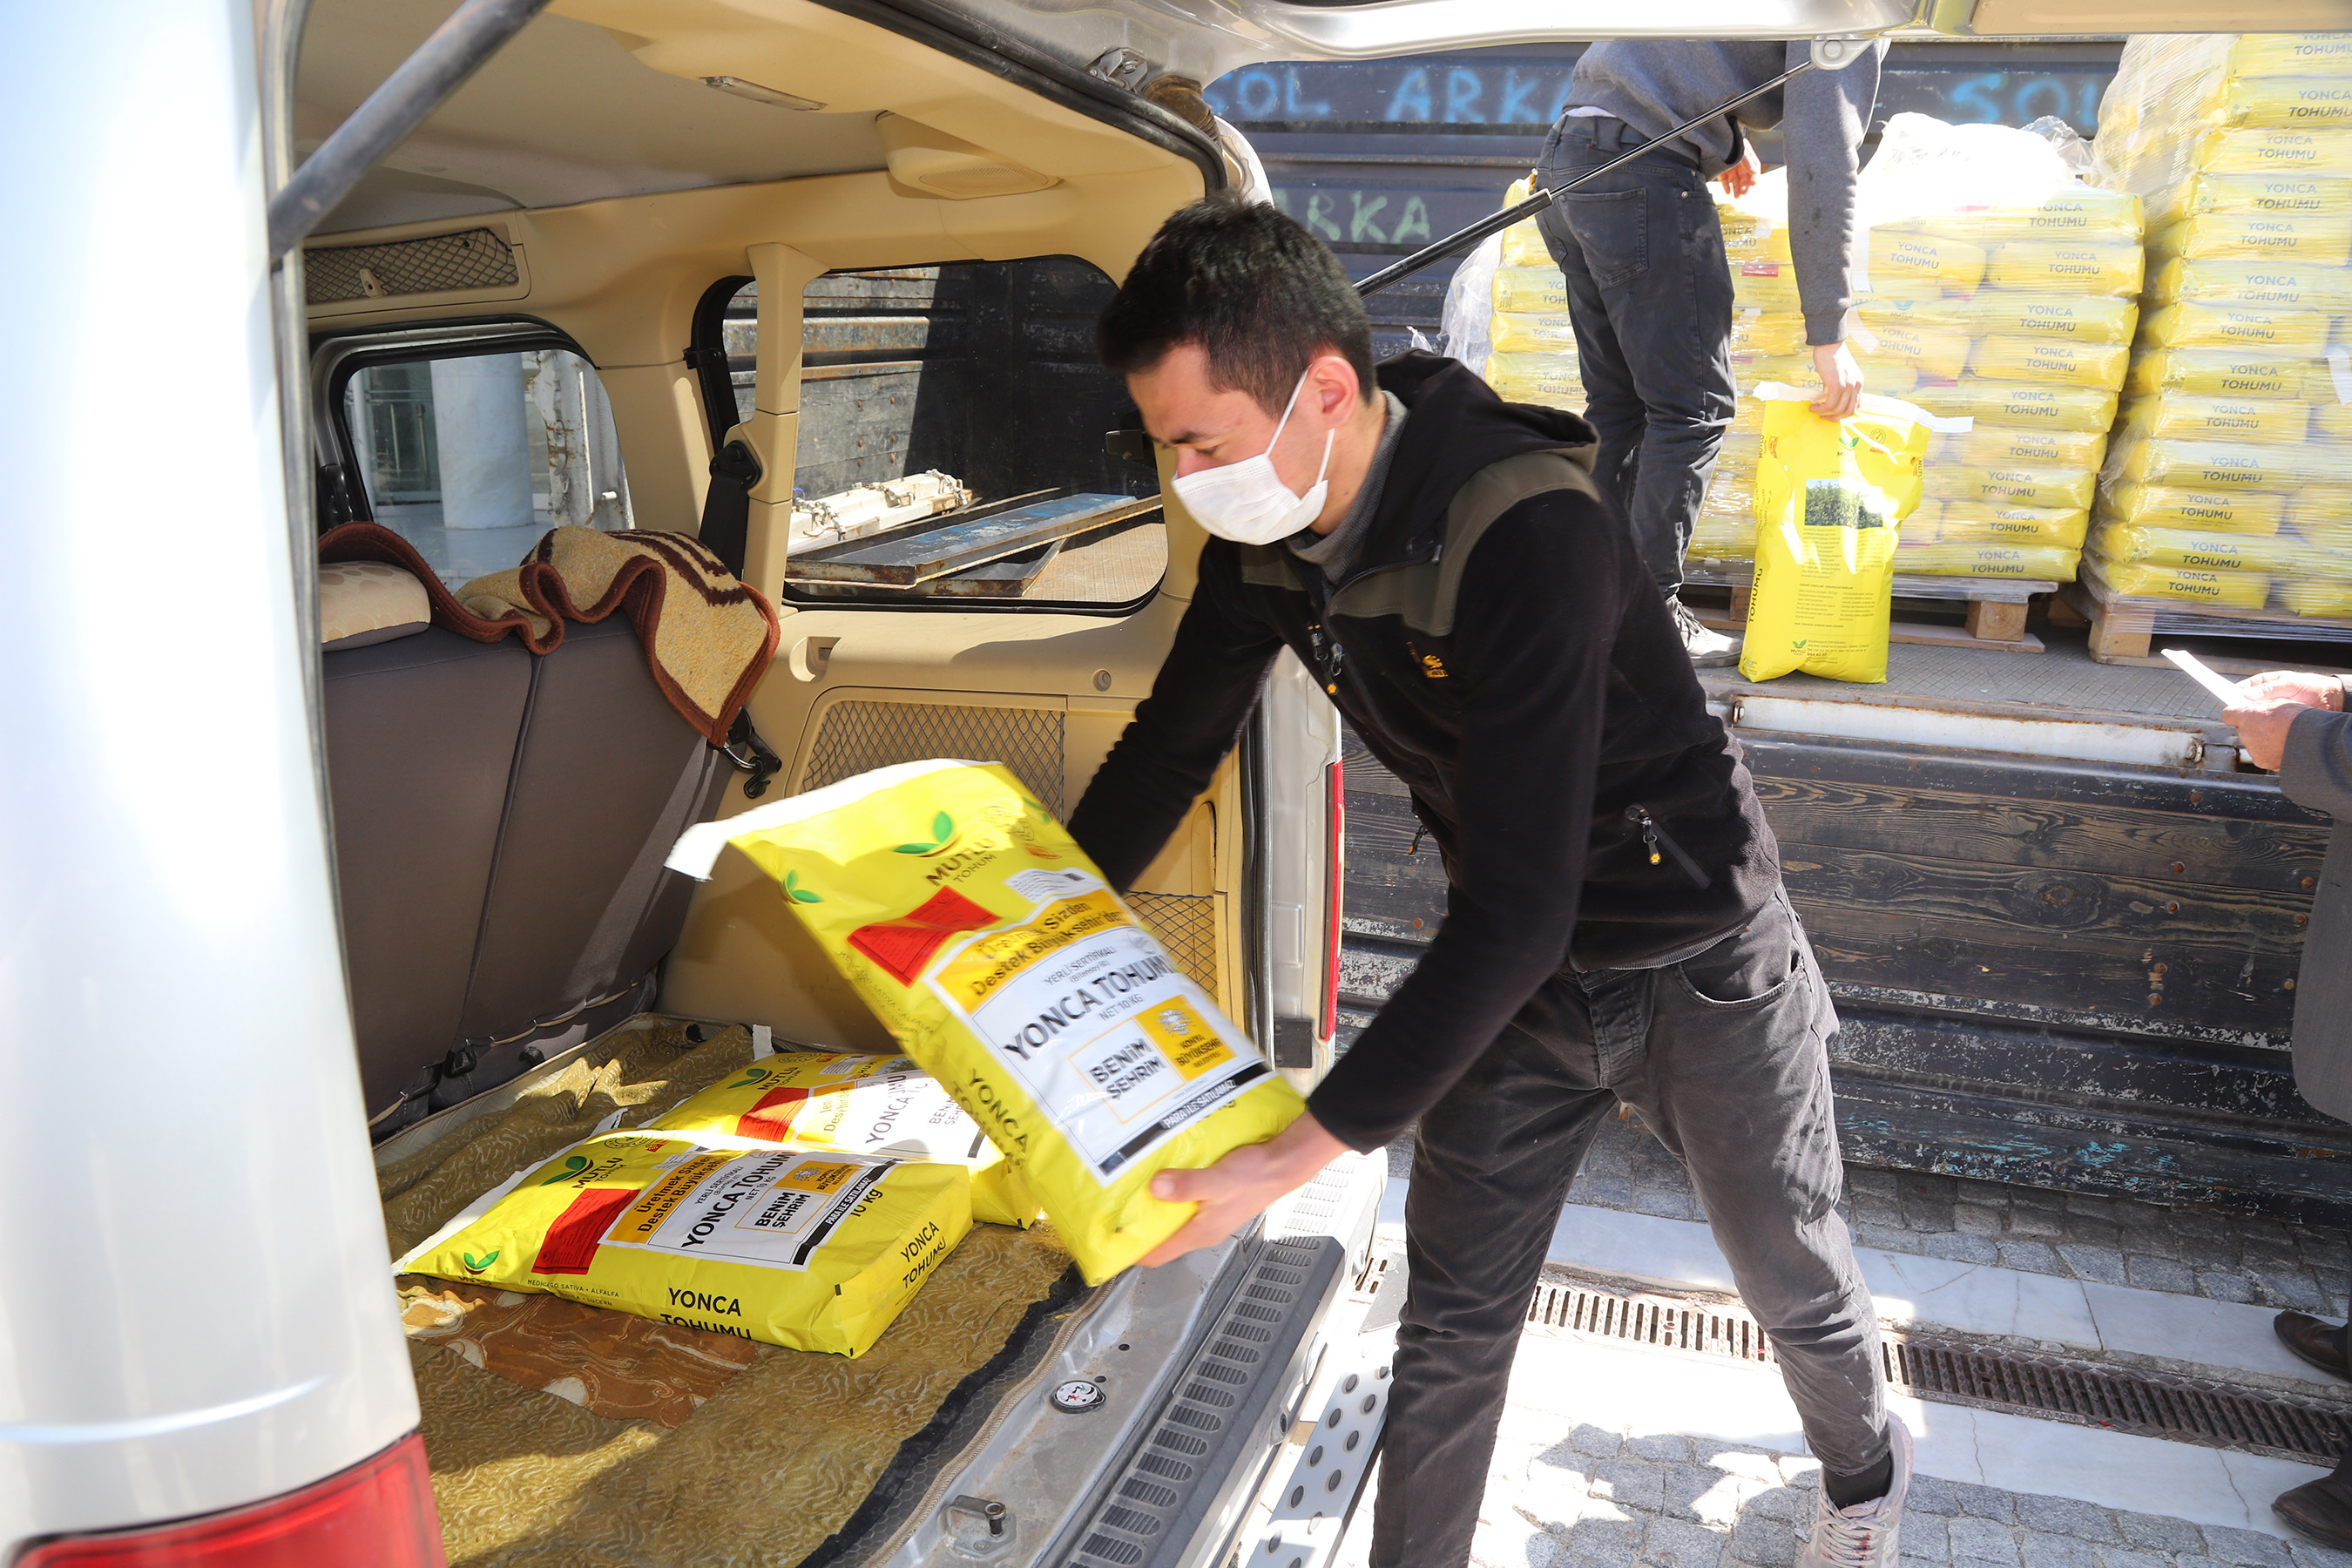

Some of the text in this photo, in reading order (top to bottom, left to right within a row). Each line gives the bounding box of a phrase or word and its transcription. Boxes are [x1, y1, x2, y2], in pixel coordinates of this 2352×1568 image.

[2298, 90, 2352, 100] YONCA
[2266, 135, 2313, 145] YONCA
[2257, 148, 2316, 159] TOHUMU
[2265, 184, 2317, 193] YONCA
[2255, 199, 2321, 210] TOHUMU
[2029, 217, 2087, 227] TOHUMU
[2247, 222, 2294, 233] YONCA
[2240, 235, 2297, 247] TOHUMU
[1897, 241, 1937, 257] YONCA
[1890, 253, 1940, 269] TOHUMU
[2055, 251, 2097, 261] YONCA
[2048, 263, 2100, 274] TOHUMU
[2245, 275, 2296, 287] YONCA
[1543, 294, 1566, 305] TOH
[2237, 290, 2300, 302] TOHUMU
[2027, 305, 2073, 317] YONCA
[2227, 313, 2272, 324] YONCA
[2019, 319, 2076, 332] TOHUMU
[1882, 327, 1920, 341] YONCA
[2220, 326, 2275, 339] TOHUMU
[1880, 340, 1922, 355] OHUMU
[2033, 347, 2074, 358] YONCA
[2026, 358, 2077, 372] TOHUMU
[2229, 365, 2279, 376] YONCA
[2220, 379, 2281, 391] TOHUMU
[2011, 391, 2055, 402] YONCA
[2004, 404, 2058, 417] TOHUMU
[2212, 405, 2256, 416] YONCA
[2206, 417, 2260, 429] TOHUMU
[2016, 435, 2056, 446] YONCA
[2010, 448, 2058, 459] TOHUMU
[2211, 456, 2260, 468] YONCA
[1988, 471, 2033, 483] YONCA
[2203, 470, 2263, 483] TOHUMU
[1981, 484, 2036, 497] TOHUMU
[2186, 494, 2230, 506] YONCA
[1996, 510, 2036, 521] YONCA
[2180, 507, 2233, 520] TOHUMU
[1990, 523, 2038, 534] TOHUMU
[2191, 541, 2239, 555] YONCA
[1977, 551, 2021, 560] YONCA
[2182, 555, 2241, 569] TOHUMU
[1971, 562, 2024, 574] TOHUMU
[2175, 570, 2217, 583] YONCA
[2168, 582, 2220, 596] TOHUMU
[1748, 568, 1763, 624] TOHUMU
[925, 837, 996, 887] MUTLU
[953, 853, 997, 884] TOHUM
[1044, 901, 1093, 930] Sizden
[969, 950, 1031, 997] Destek
[1004, 955, 1176, 1062] YONCA TOHUM
[1098, 1004, 1119, 1022] NET
[758, 1066, 799, 1091] MUTLU
[969, 1067, 1029, 1153] YONCA
[1161, 1109, 1188, 1129] PARA
[1196, 1078, 1238, 1106] SATILAMAZ
[865, 1096, 916, 1145] YONCA
[571, 1157, 624, 1189] MUTLU
[636, 1174, 683, 1213] Üretmek
[681, 1191, 747, 1247] YONCA
[731, 1152, 797, 1190] TOHUM
[745, 1188, 760, 1200] NET
[826, 1210, 841, 1225] PARA
[845, 1177, 873, 1205] SATILAMAZ
[637, 1193, 678, 1232] Destek
[754, 1192, 796, 1227] BENİM
[772, 1193, 811, 1230] ŞEHRİM
[900, 1220, 940, 1263] YONCA
[591, 1288, 619, 1297] ALFALFA
[668, 1288, 741, 1317] YONCA
